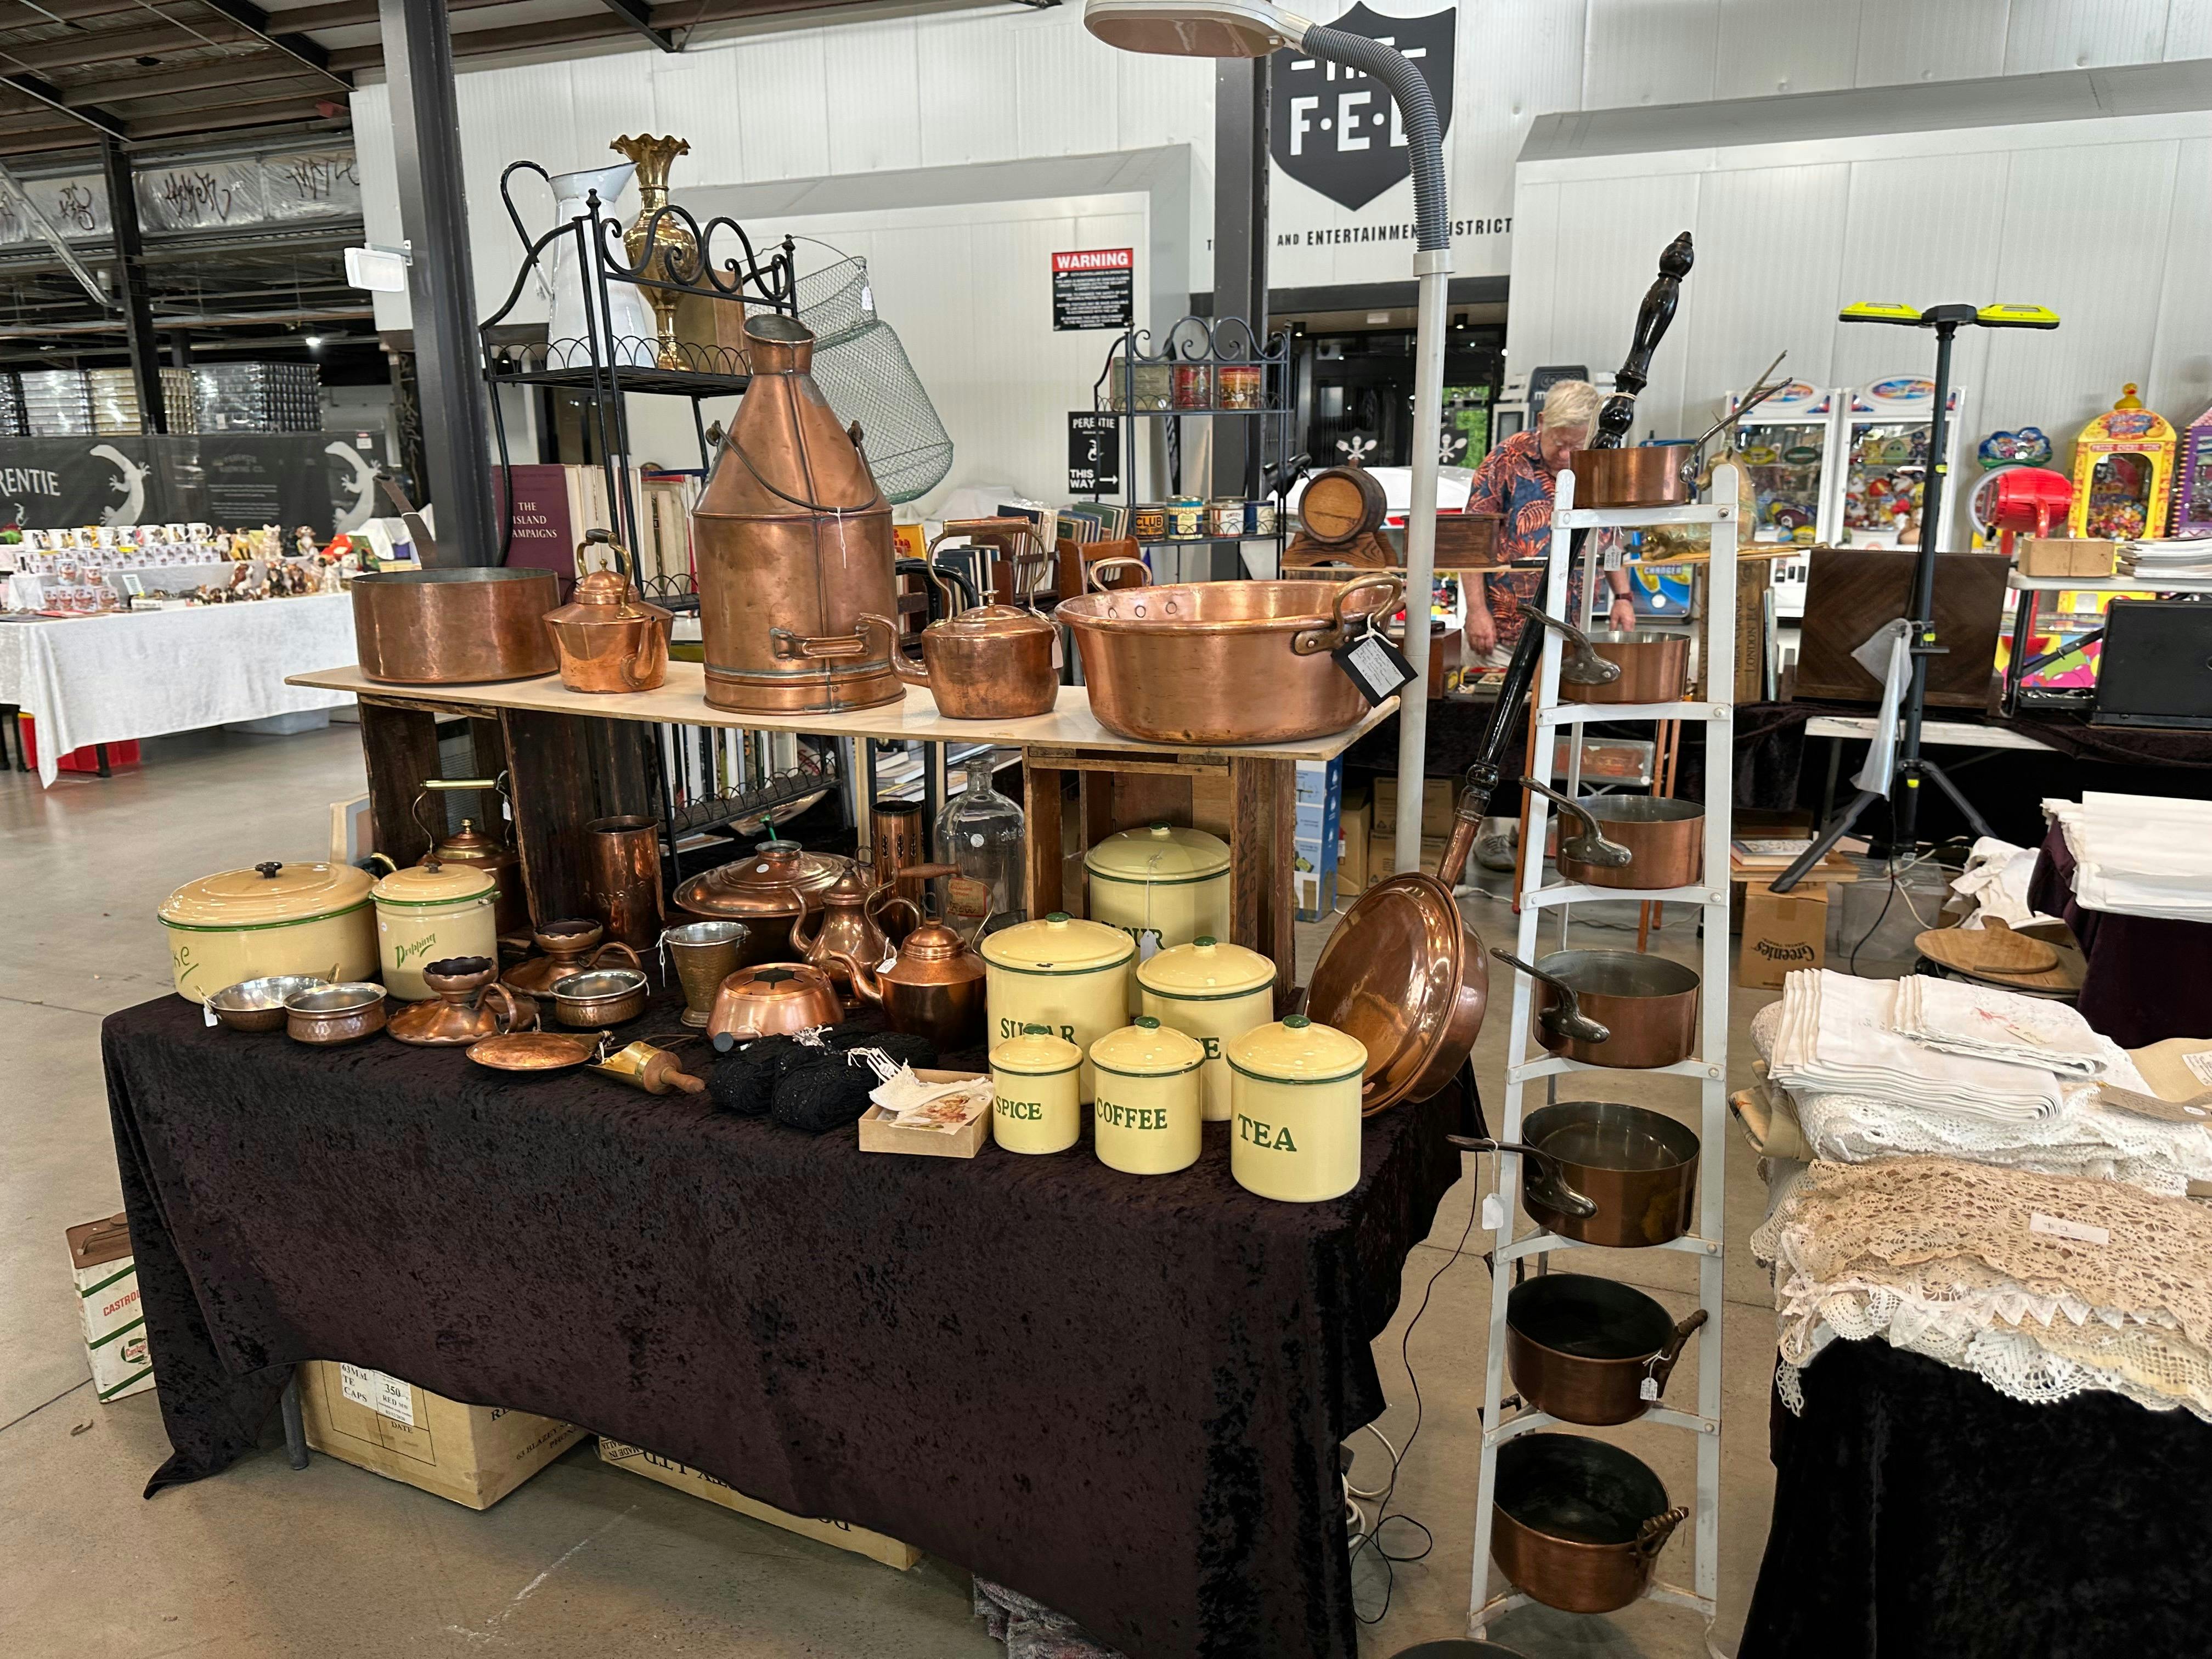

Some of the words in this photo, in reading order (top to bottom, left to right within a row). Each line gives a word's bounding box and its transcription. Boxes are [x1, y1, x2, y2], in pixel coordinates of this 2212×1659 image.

[1277, 234, 1300, 246] AND
[1307, 224, 1418, 245] ENTERTAINMEN
[1449, 218, 1513, 236] ISTRICT
[1057, 252, 1128, 269] WARNING
[1073, 417, 1115, 428] PERETIE
[1070, 469, 1094, 478] THIS
[1070, 479, 1096, 489] WAY
[517, 502, 537, 511] THE
[512, 516, 547, 524] ISLAND
[1136, 517, 1162, 527] CLUB
[512, 529, 557, 538] AMPAIGNS
[1644, 566, 1682, 575] CHANGER
[1745, 627, 1757, 673] LONDON
[395, 933, 436, 969] Dripping
[1753, 941, 1815, 962] Greenies
[1001, 1018, 1077, 1046] SUR
[996, 1095, 1042, 1120] SPICE
[1097, 1097, 1167, 1130] COFFEE
[1238, 1113, 1297, 1152] TEA
[343, 1375, 354, 1386] TE
[344, 1387, 367, 1402] CAPS
[385, 1384, 401, 1397] 350
[382, 1395, 397, 1406] RED
[391, 1421, 413, 1434] DATE
